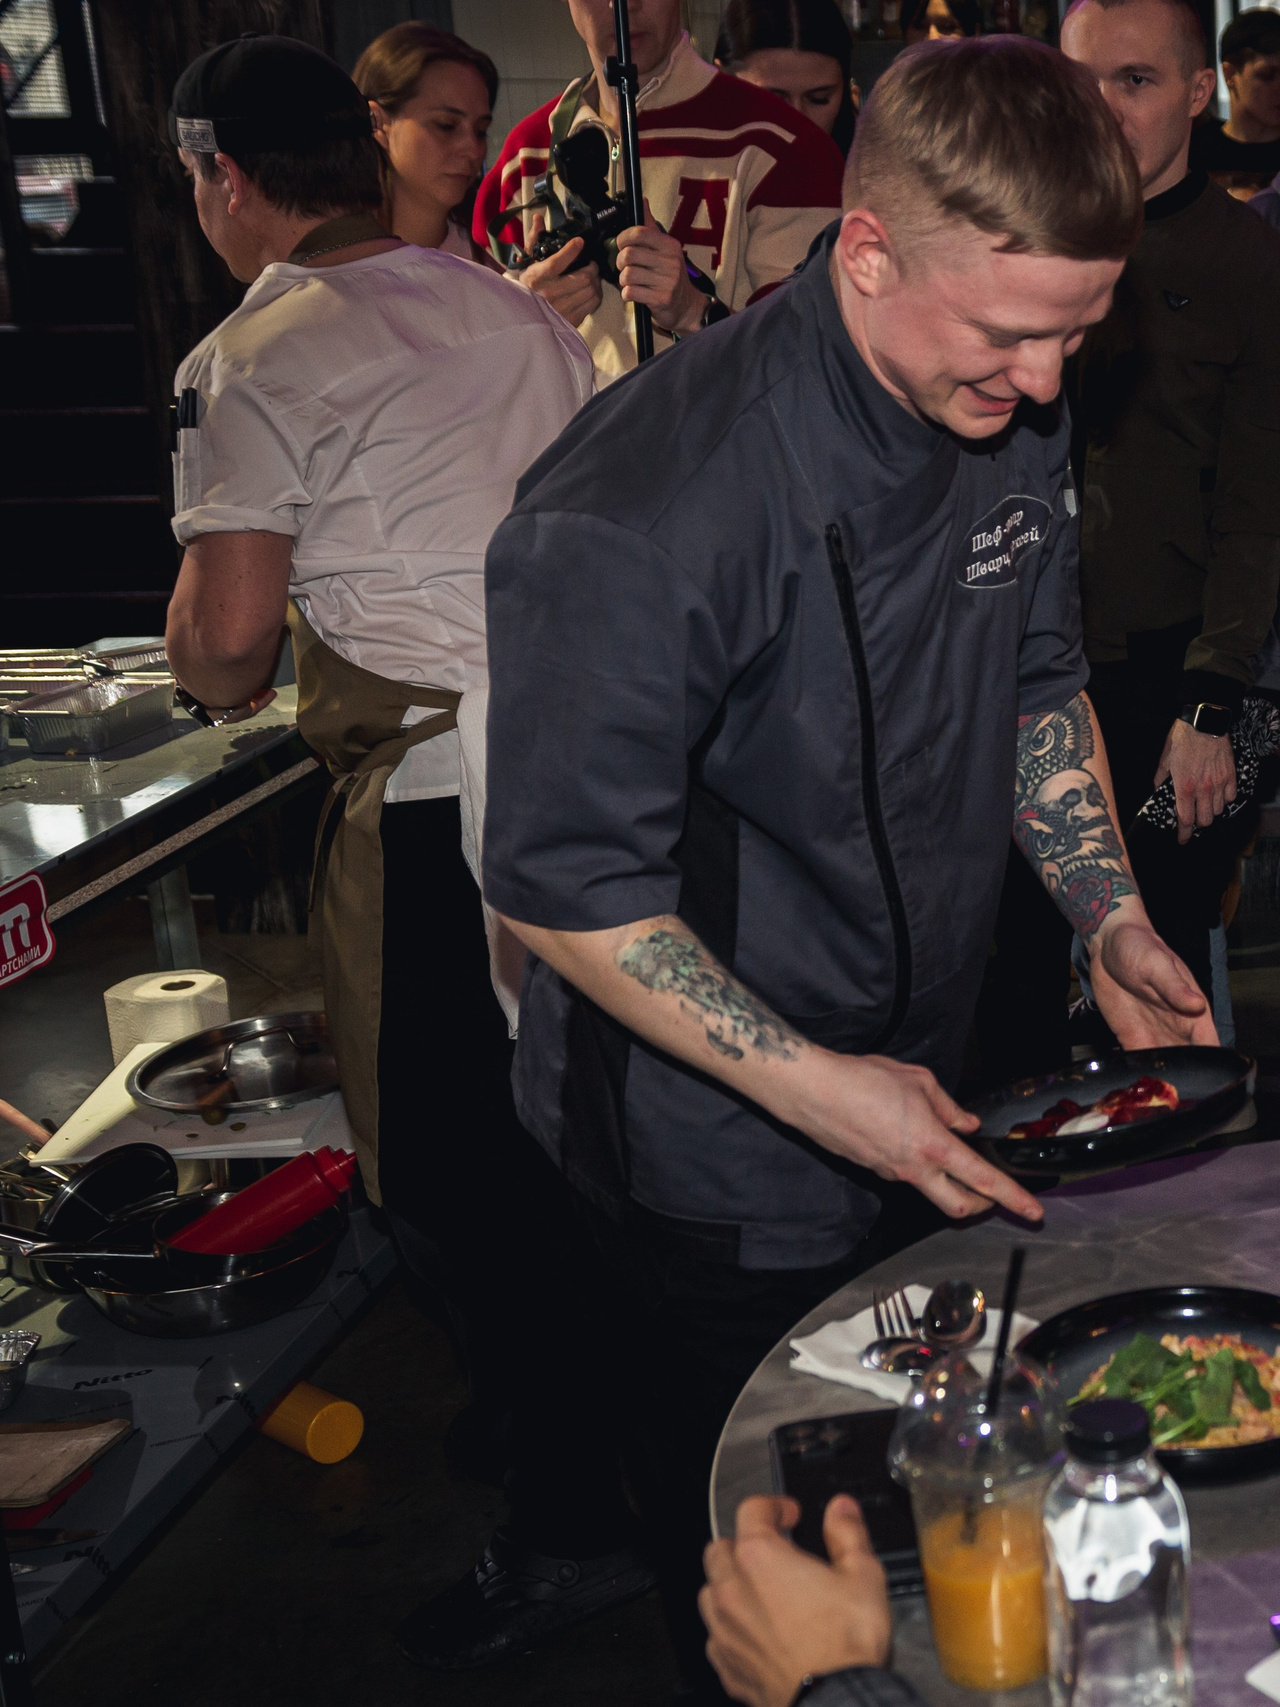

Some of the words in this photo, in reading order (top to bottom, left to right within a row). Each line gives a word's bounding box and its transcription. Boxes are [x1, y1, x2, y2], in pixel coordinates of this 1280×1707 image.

[596, 205, 617, 220] Nikon
[0, 944, 41, 977] РТСНАМИ
[72, 1369, 153, 1390] Nitto
